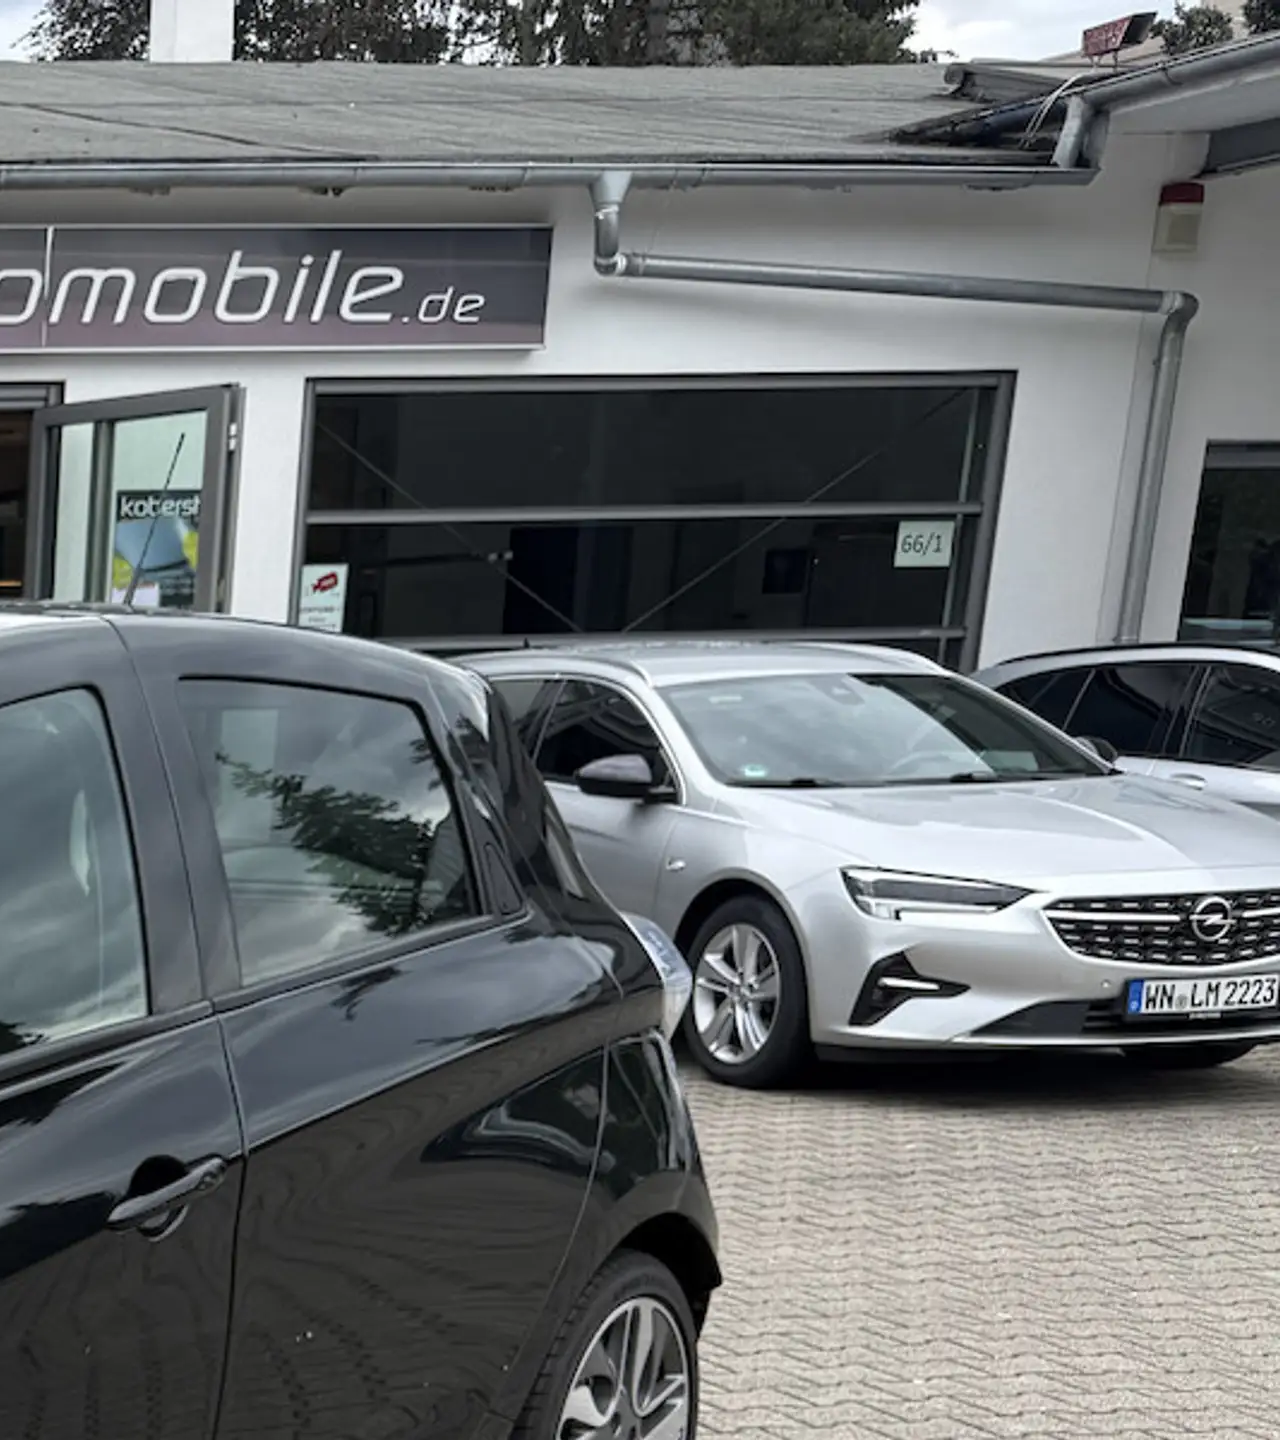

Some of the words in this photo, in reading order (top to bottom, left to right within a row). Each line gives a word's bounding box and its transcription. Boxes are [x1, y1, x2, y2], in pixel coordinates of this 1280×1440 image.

[901, 532, 943, 556] 66/1
[1145, 984, 1176, 1010] WN
[1191, 981, 1222, 1008] LM
[1224, 977, 1277, 1007] 2223
